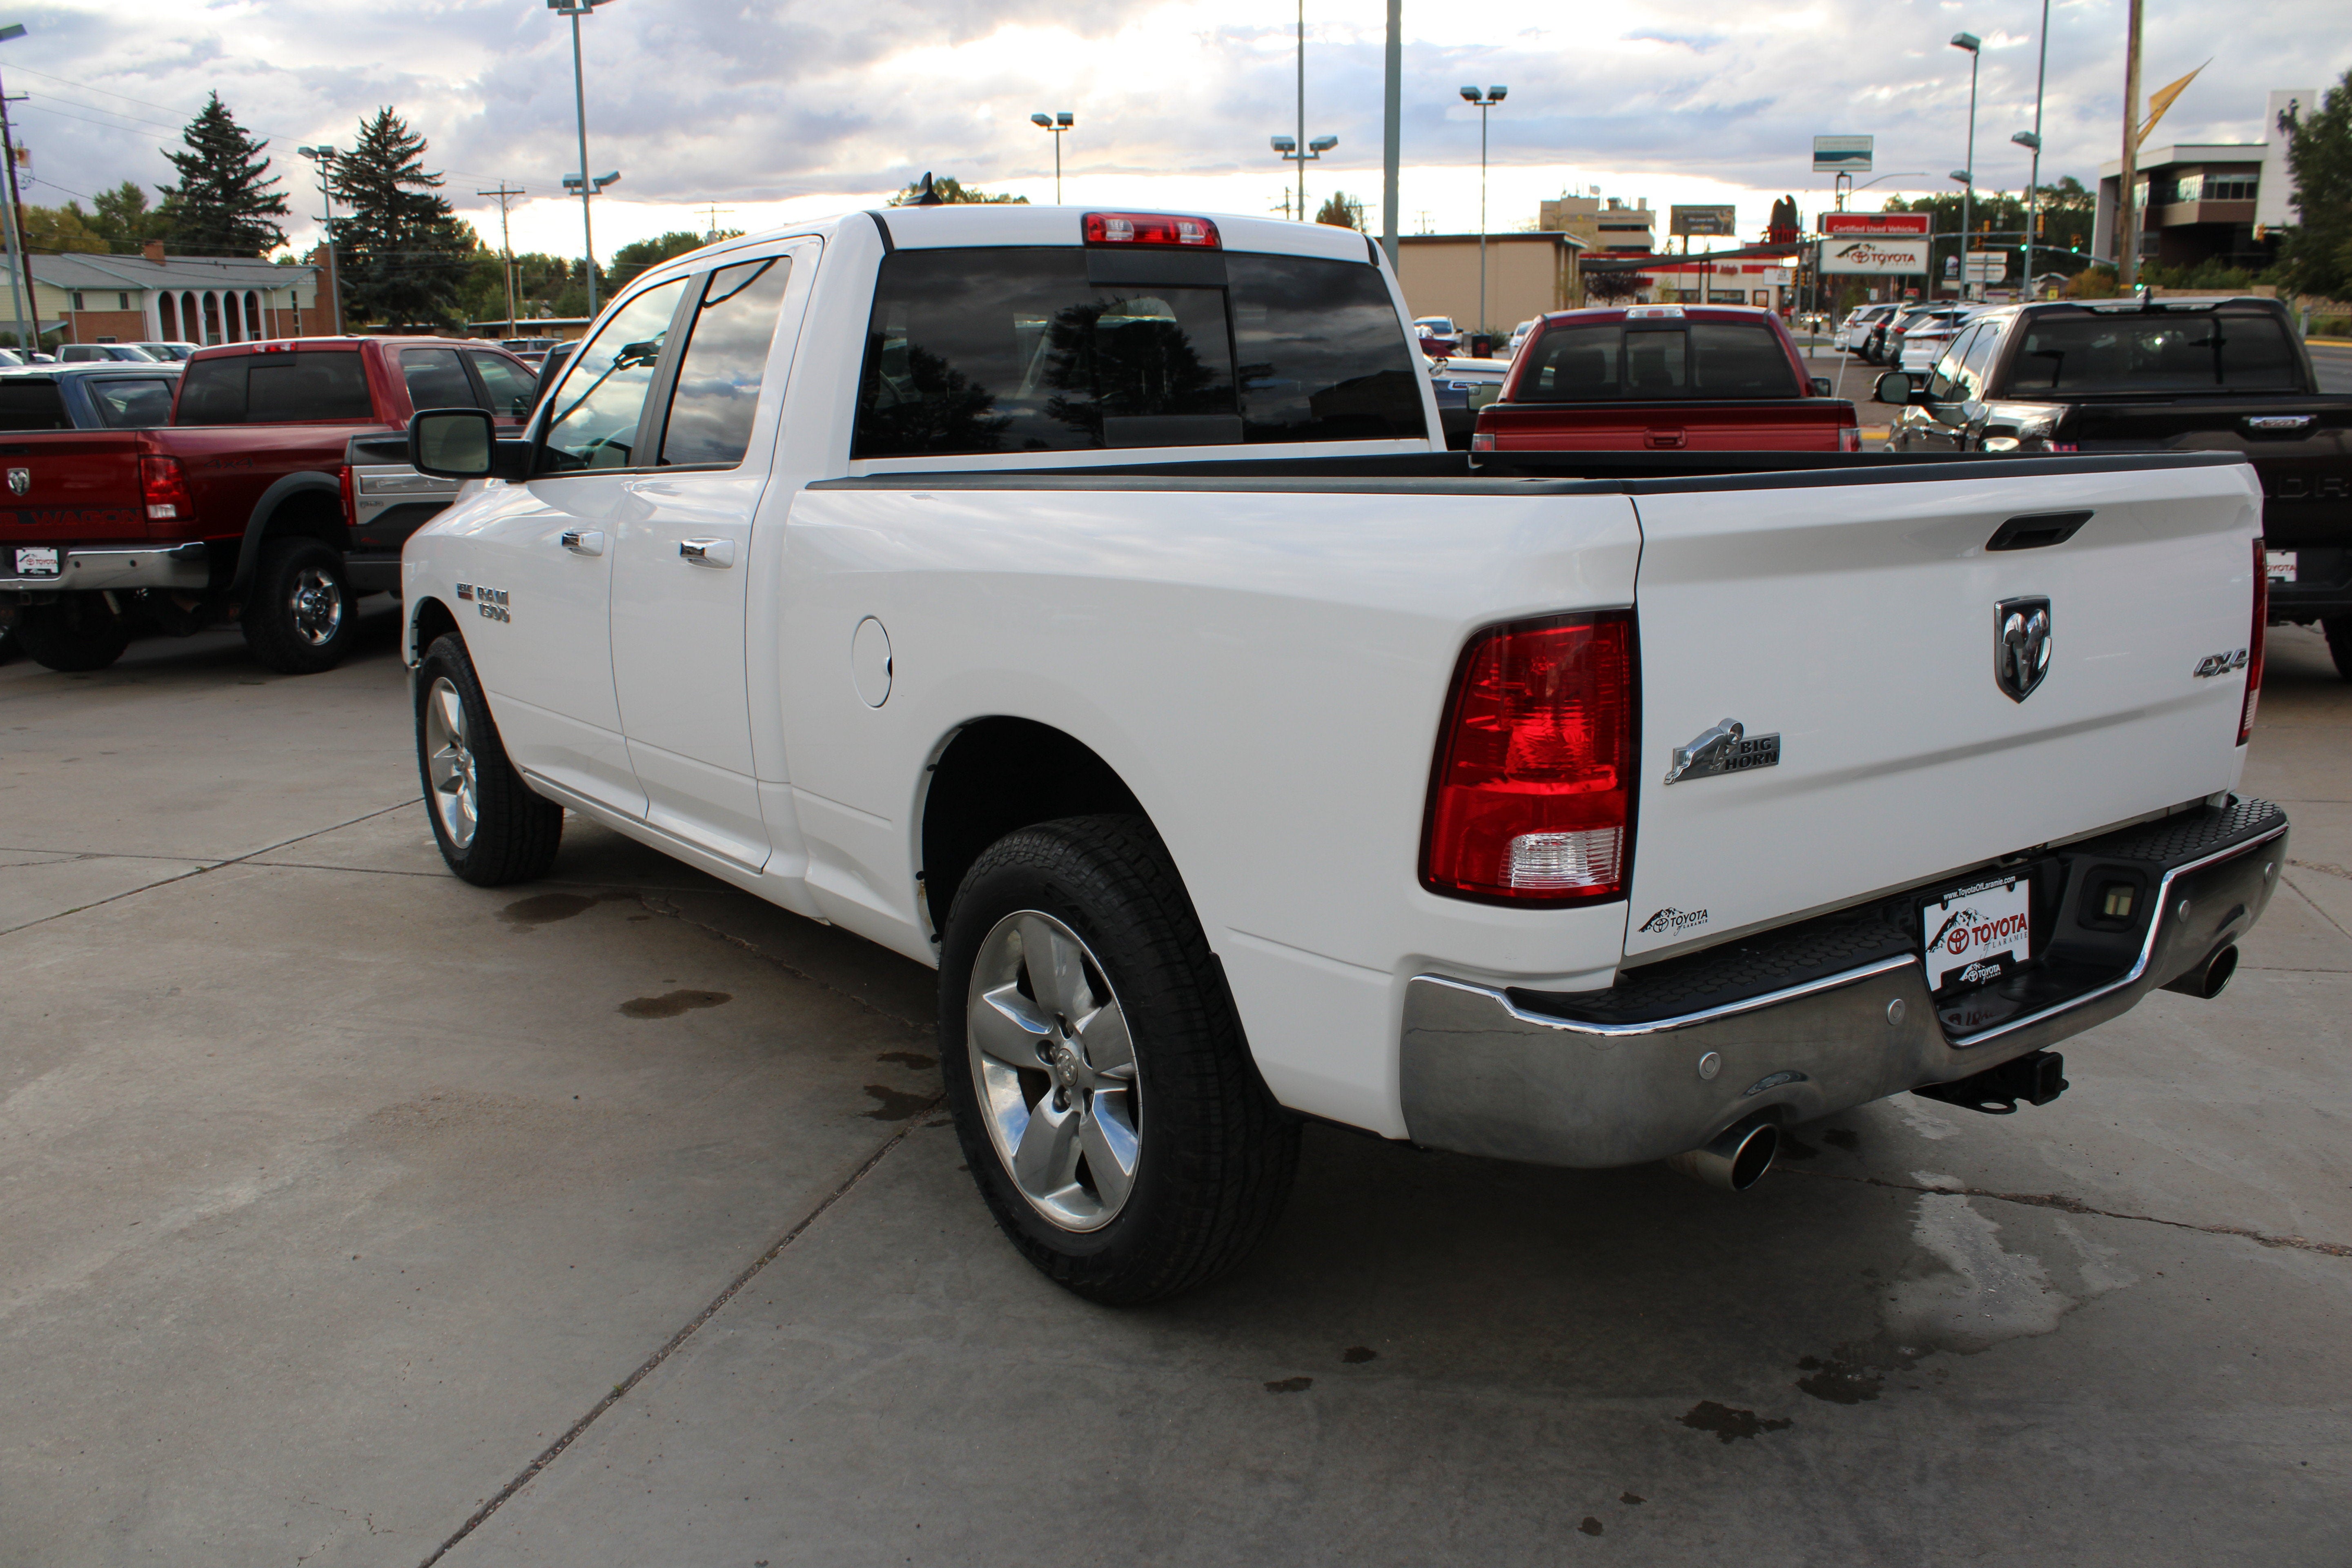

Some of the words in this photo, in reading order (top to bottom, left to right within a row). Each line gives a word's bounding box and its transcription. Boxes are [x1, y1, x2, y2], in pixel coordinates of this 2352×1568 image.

[1871, 253, 1916, 262] TOYOTA
[476, 585, 510, 606] RAM
[477, 602, 511, 624] 1500
[1740, 738, 1772, 754] BIG
[1724, 751, 1777, 771] HORN
[1943, 875, 2016, 900] www.ToyotaOfLaramie.com
[1670, 909, 1708, 927] TOYOTA
[1683, 919, 1708, 929] LARAMIE
[1972, 913, 2028, 946] TOYOTA
[1991, 931, 2028, 949] LARAMIE
[1978, 964, 2001, 978] TOYOTA
